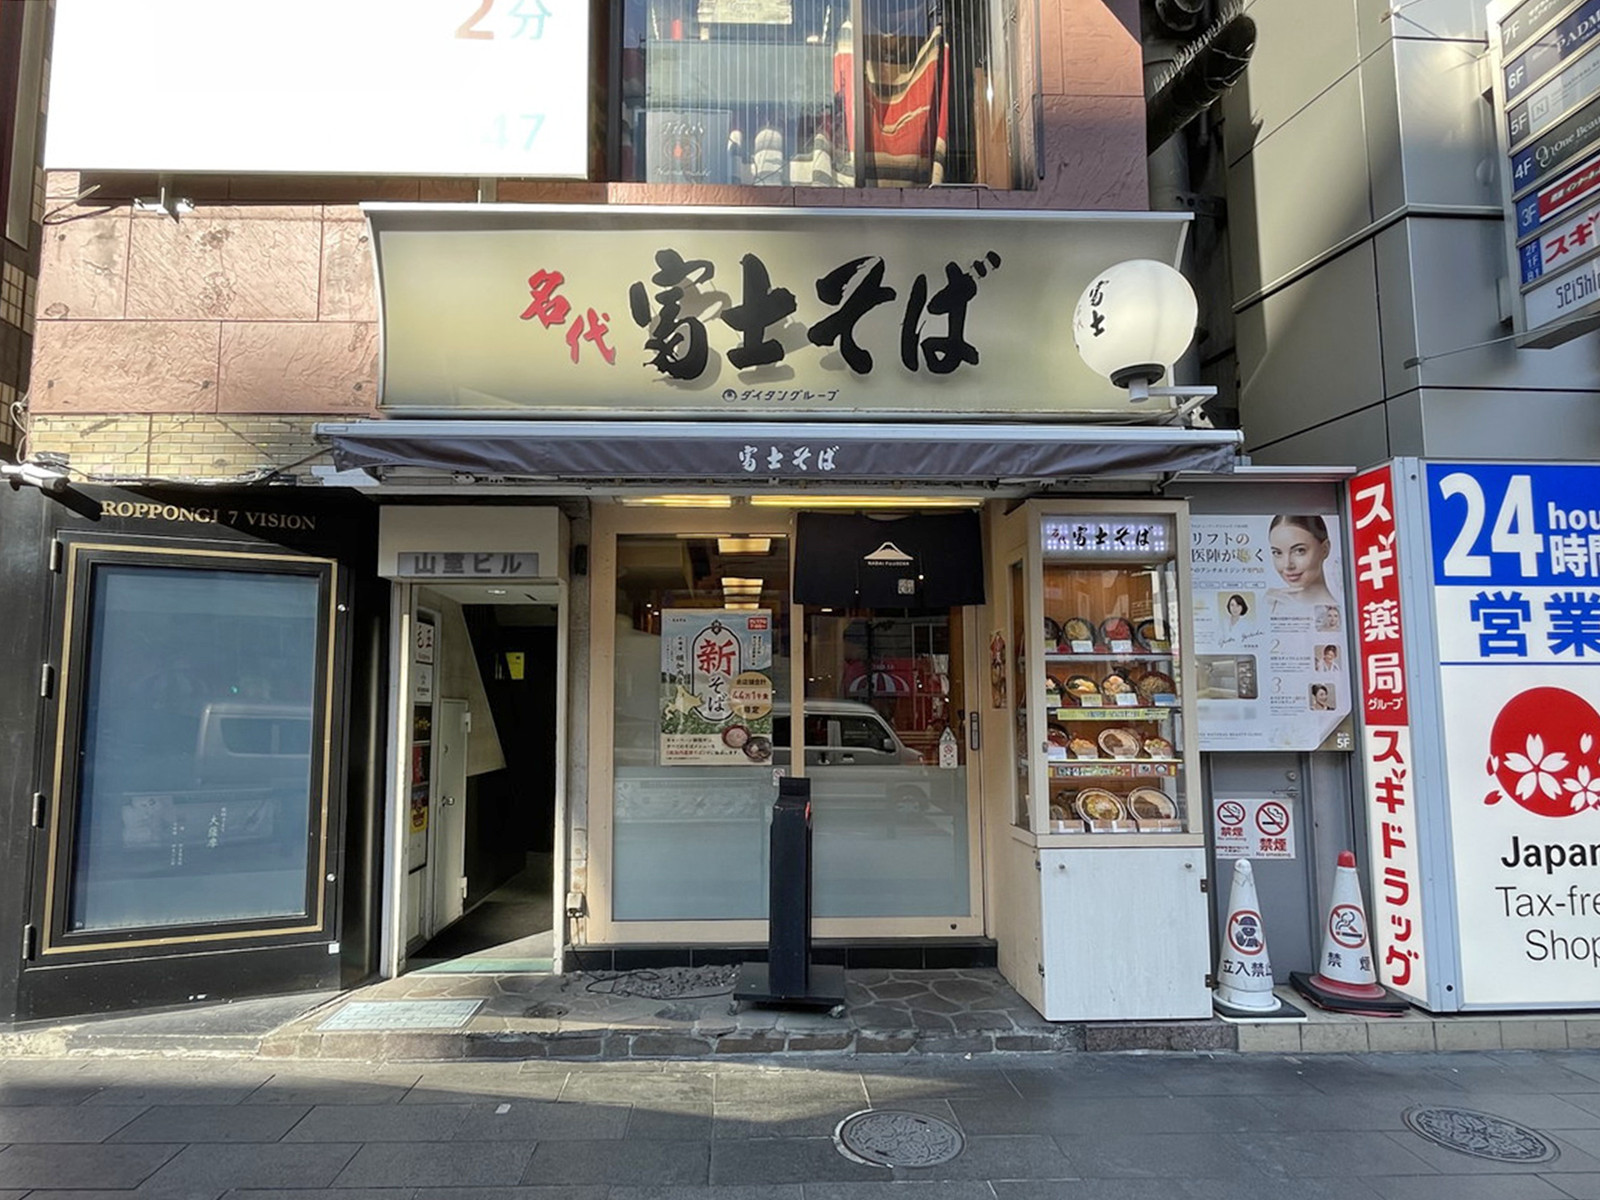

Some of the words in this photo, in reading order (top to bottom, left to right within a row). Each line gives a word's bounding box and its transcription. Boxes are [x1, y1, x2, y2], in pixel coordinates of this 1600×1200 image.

[1503, 20, 1520, 45] 7F
[1507, 65, 1524, 90] 6F
[1511, 112, 1528, 136] 5F
[1514, 157, 1532, 180] 4F
[1521, 202, 1537, 227] 3F
[1525, 243, 1538, 257] 2F
[1527, 256, 1539, 268] 1F
[1527, 268, 1540, 282] B1
[519, 267, 617, 367] 名代
[627, 248, 1002, 381] 富士そば
[741, 389, 840, 401] ダイタングループ
[739, 445, 840, 472] 富士そば
[100, 499, 219, 524] ROPPONGI
[228, 510, 239, 525] 7
[246, 512, 317, 531] VISION
[1438, 472, 1545, 578] 24
[1073, 526, 1154, 547] 富士そば
[1354, 482, 1401, 695] スギ薬局
[1469, 590, 1600, 658] 営業
[1368, 697, 1404, 711] グループ
[1337, 737, 1350, 749] 5F
[1220, 826, 1244, 837] 禁煙
[1259, 838, 1288, 852] 禁煙
[1373, 730, 1419, 986] スギドラッグ
